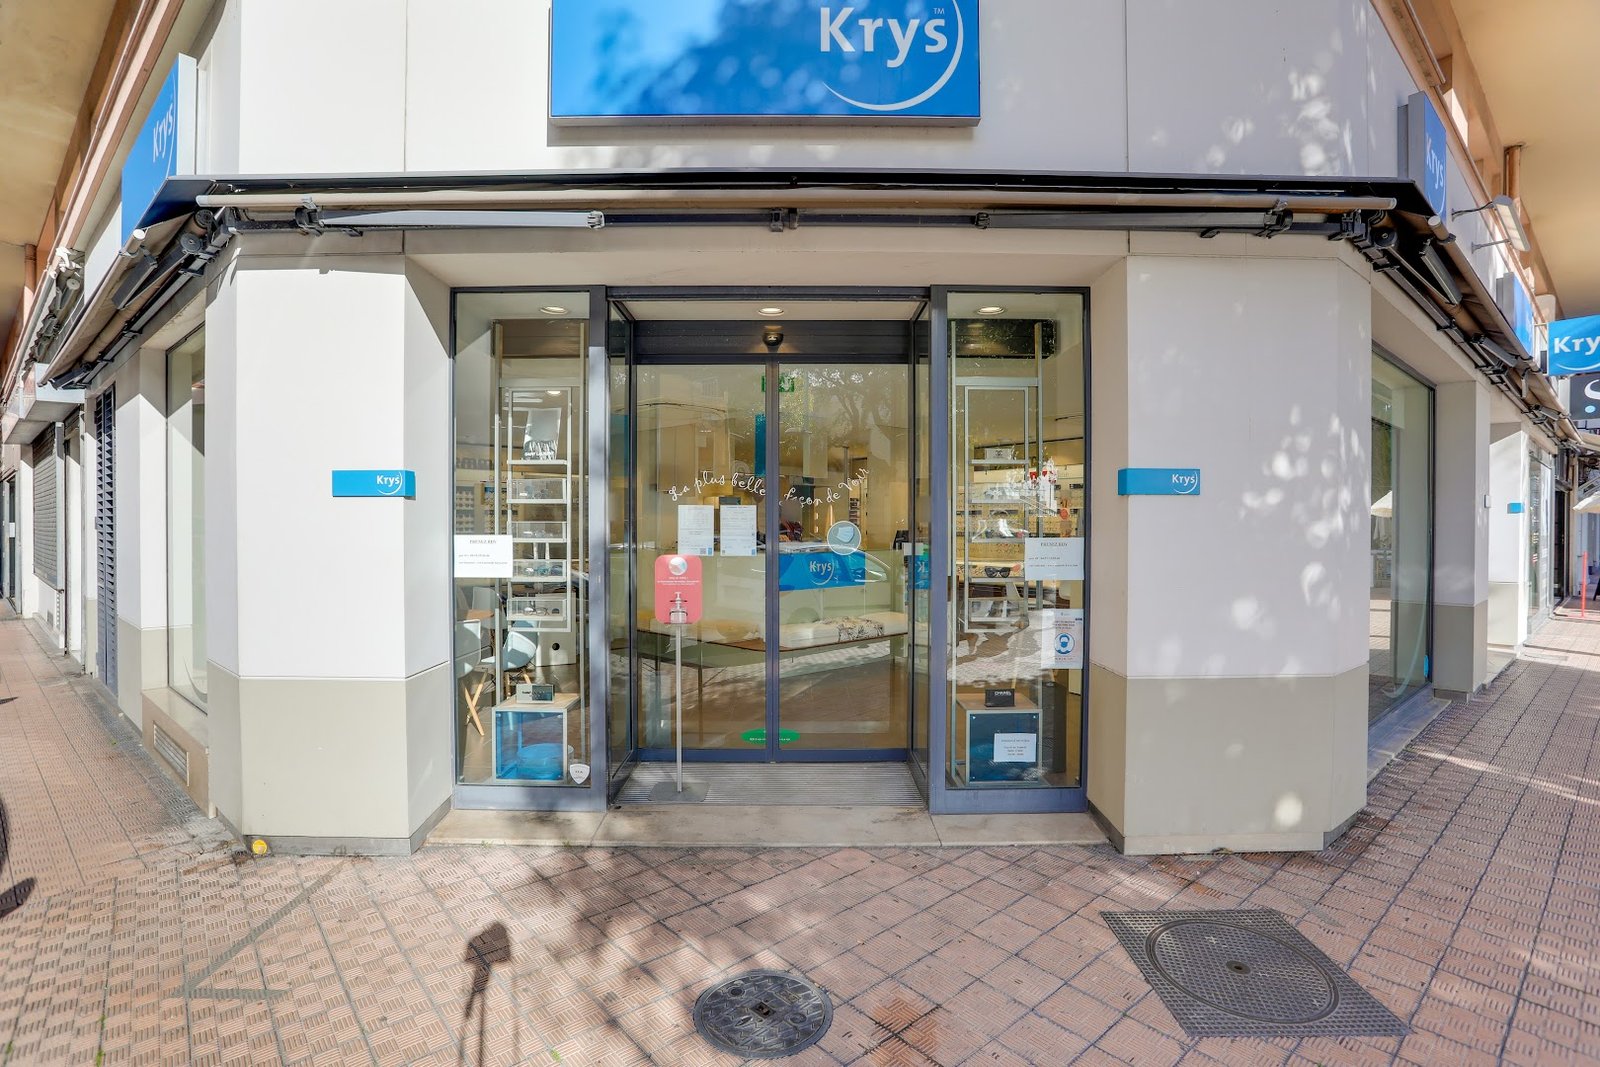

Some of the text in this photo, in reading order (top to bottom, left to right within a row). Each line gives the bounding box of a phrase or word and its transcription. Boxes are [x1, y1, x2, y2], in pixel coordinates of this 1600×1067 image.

[820, 7, 948, 68] Krys
[153, 103, 173, 163] Krys
[1425, 132, 1444, 190] Krys
[376, 475, 400, 487] Krys
[694, 470, 725, 494] plus
[731, 472, 766, 496] belle
[826, 487, 841, 503] de
[1172, 474, 1195, 486] Krys
[809, 560, 832, 576] Krys
